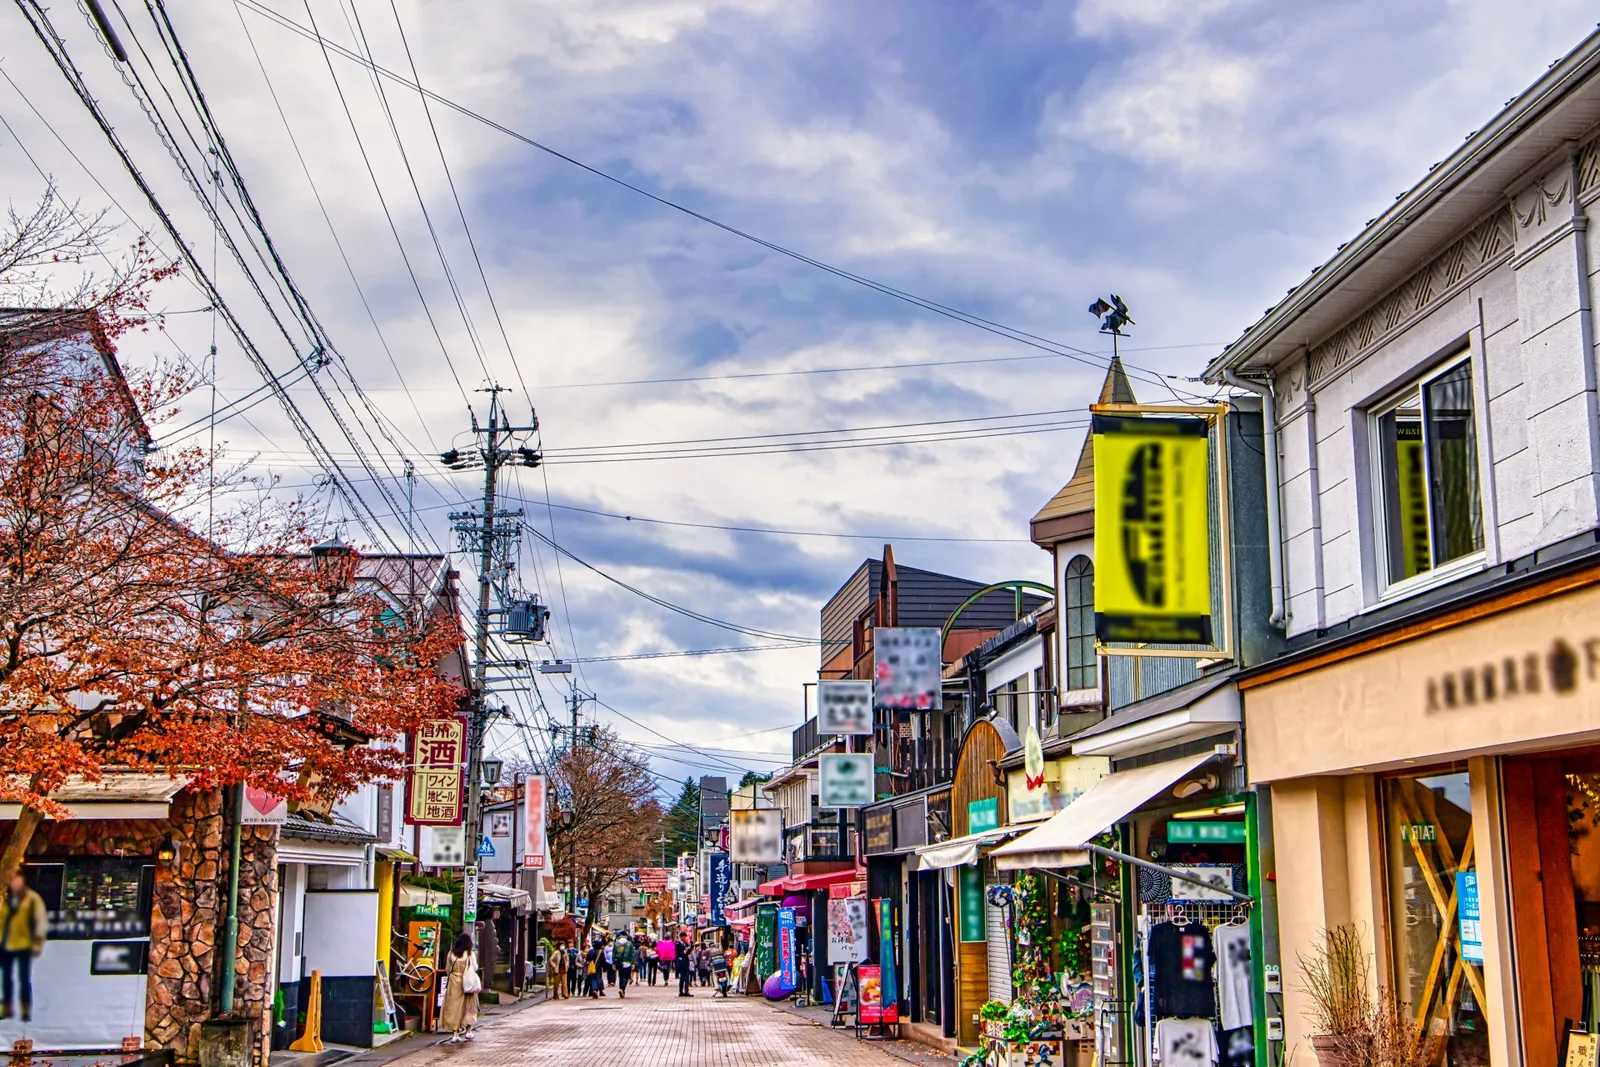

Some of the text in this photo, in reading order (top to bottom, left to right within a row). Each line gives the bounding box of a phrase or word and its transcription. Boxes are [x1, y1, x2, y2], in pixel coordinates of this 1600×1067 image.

[421, 722, 458, 738] 信州の
[419, 739, 458, 770] 酒
[428, 775, 456, 788] ワイン
[427, 790, 455, 803] 地ビール
[426, 805, 454, 818] 地酒
